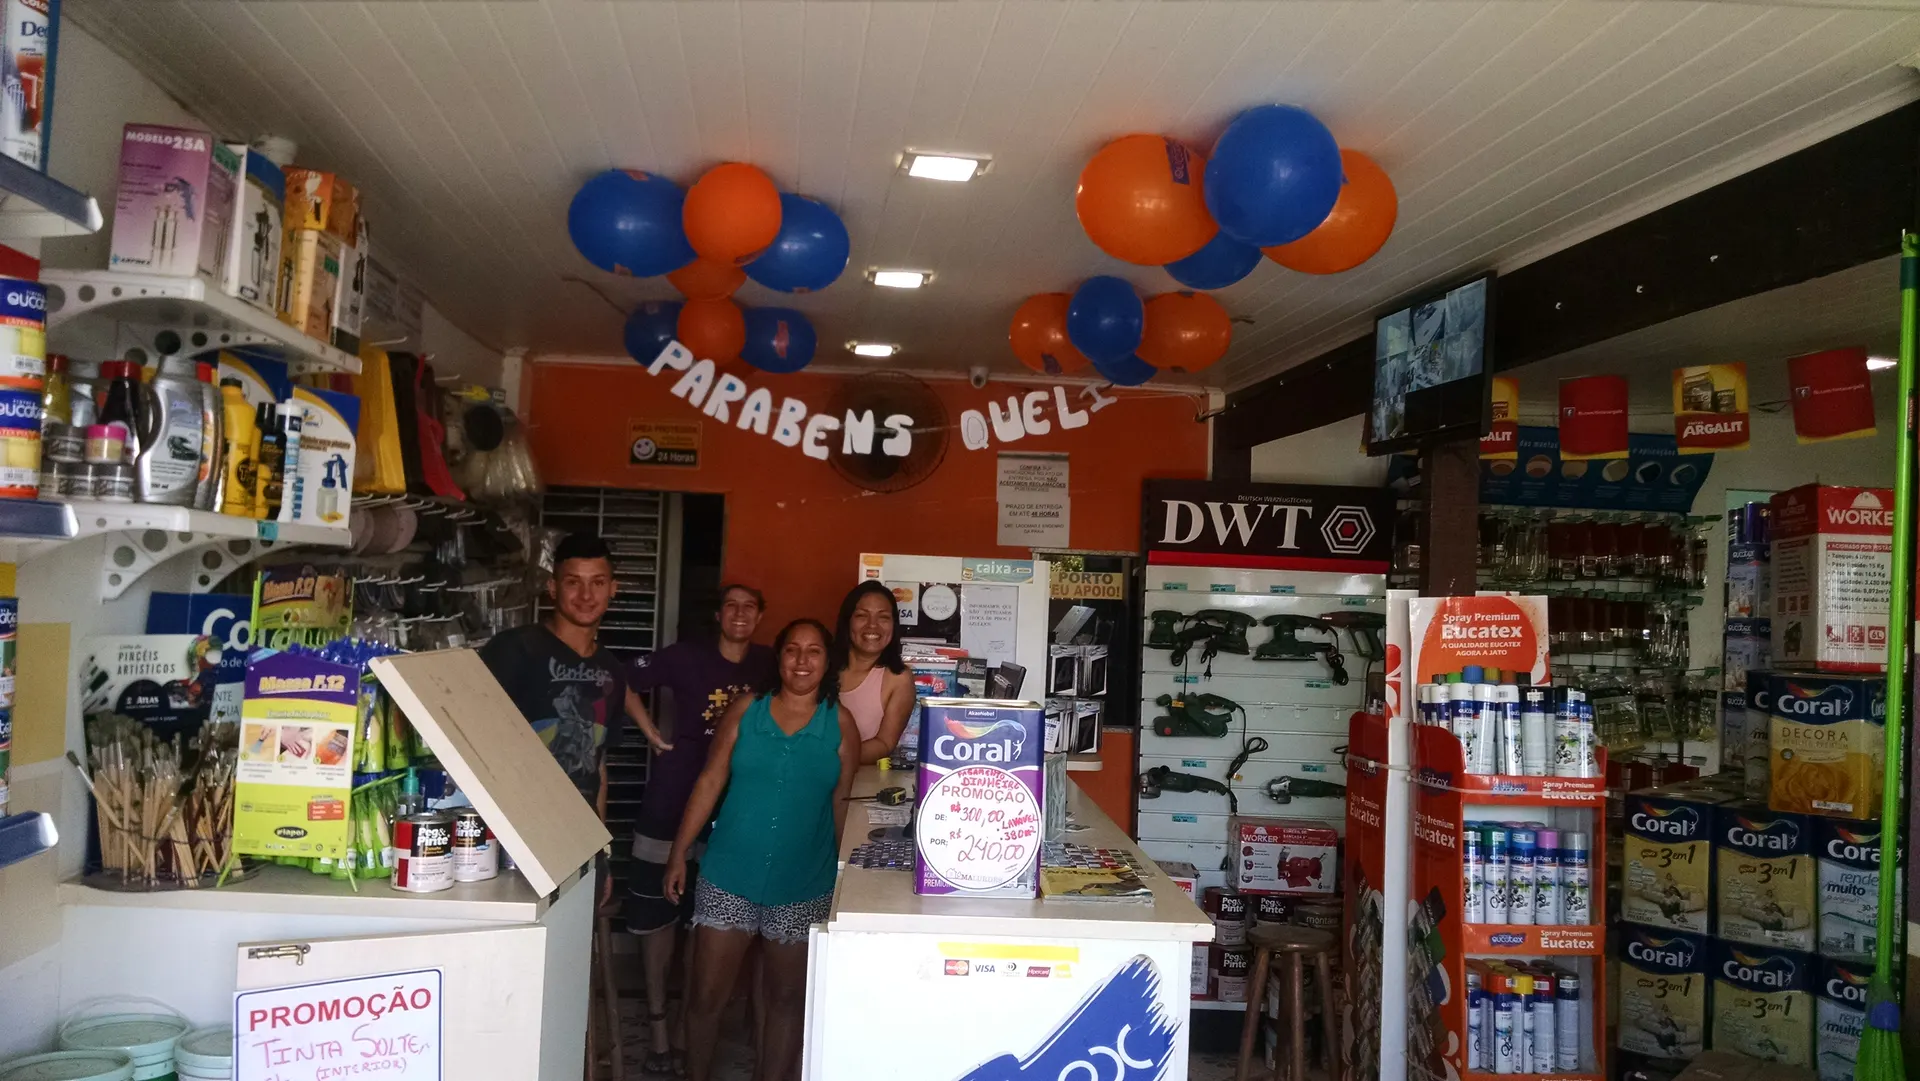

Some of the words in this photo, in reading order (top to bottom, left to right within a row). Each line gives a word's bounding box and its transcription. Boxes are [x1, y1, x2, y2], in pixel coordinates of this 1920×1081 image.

[647, 340, 914, 460] PARABENS
[960, 383, 1118, 451] QUELI
[1683, 421, 1743, 438] ARGALIT
[1158, 500, 1313, 549] DWT
[1827, 508, 1894, 526] WORKE
[976, 561, 1012, 575] caixa
[1058, 572, 1114, 585] PORTO
[1051, 584, 1069, 595] EU
[1074, 585, 1120, 597] APOIO!
[1443, 613, 1472, 624] Spray
[1475, 613, 1520, 622] Premium
[1442, 624, 1523, 639] Eucatex
[1872, 631, 1882, 639] 6L
[118, 648, 159, 662] PINCÉIS
[1778, 695, 1841, 716] Coral
[1782, 727, 1848, 741] DECORA
[934, 735, 1012, 762] Coral
[942, 784, 1026, 803] PROMOÇÃO
[1543, 781, 1565, 790] Spray
[1567, 781, 1595, 789] Premium
[960, 806, 1005, 828] 300,00
[1350, 802, 1380, 828] Eucatex
[456, 820, 479, 830] eg&
[456, 828, 482, 837] inte
[1631, 813, 1687, 836] Coral
[416, 835, 449, 846] Pinte
[419, 827, 446, 839] Peg&
[1242, 834, 1278, 843] WORKER
[1414, 822, 1456, 849] Eucatex
[1727, 827, 1788, 850] Coral
[957, 834, 1025, 862] 240,00
[1658, 848, 1672, 868] 3
[1688, 844, 1696, 864] 1
[1827, 839, 1881, 863] Cora
[1758, 863, 1773, 884] 3
[1773, 868, 1787, 876] em
[1789, 858, 1797, 879] 1
[1827, 881, 1866, 896] muito
[1221, 897, 1242, 906] Peg&
[1221, 904, 1244, 913] Pinte
[1260, 897, 1282, 907] Peg&
[1260, 905, 1284, 914] Pinte
[1541, 930, 1560, 938] Spray
[1541, 938, 1595, 949] Eucatex
[1224, 952, 1245, 961] Peg&
[1628, 942, 1684, 968] Coral
[975, 965, 995, 973] VISA
[1223, 960, 1246, 968] Pinte
[1723, 961, 1784, 987] Coral
[1654, 979, 1668, 998] 3
[1669, 982, 1683, 991] em
[1684, 977, 1692, 997] 1
[1826, 979, 1866, 1002] Cor
[249, 986, 432, 1032] PROMOÇÃO
[1753, 998, 1768, 1019] 3
[1768, 1002, 1783, 1010] em
[1784, 995, 1792, 1017] 1
[252, 1037, 343, 1068] TINTA
